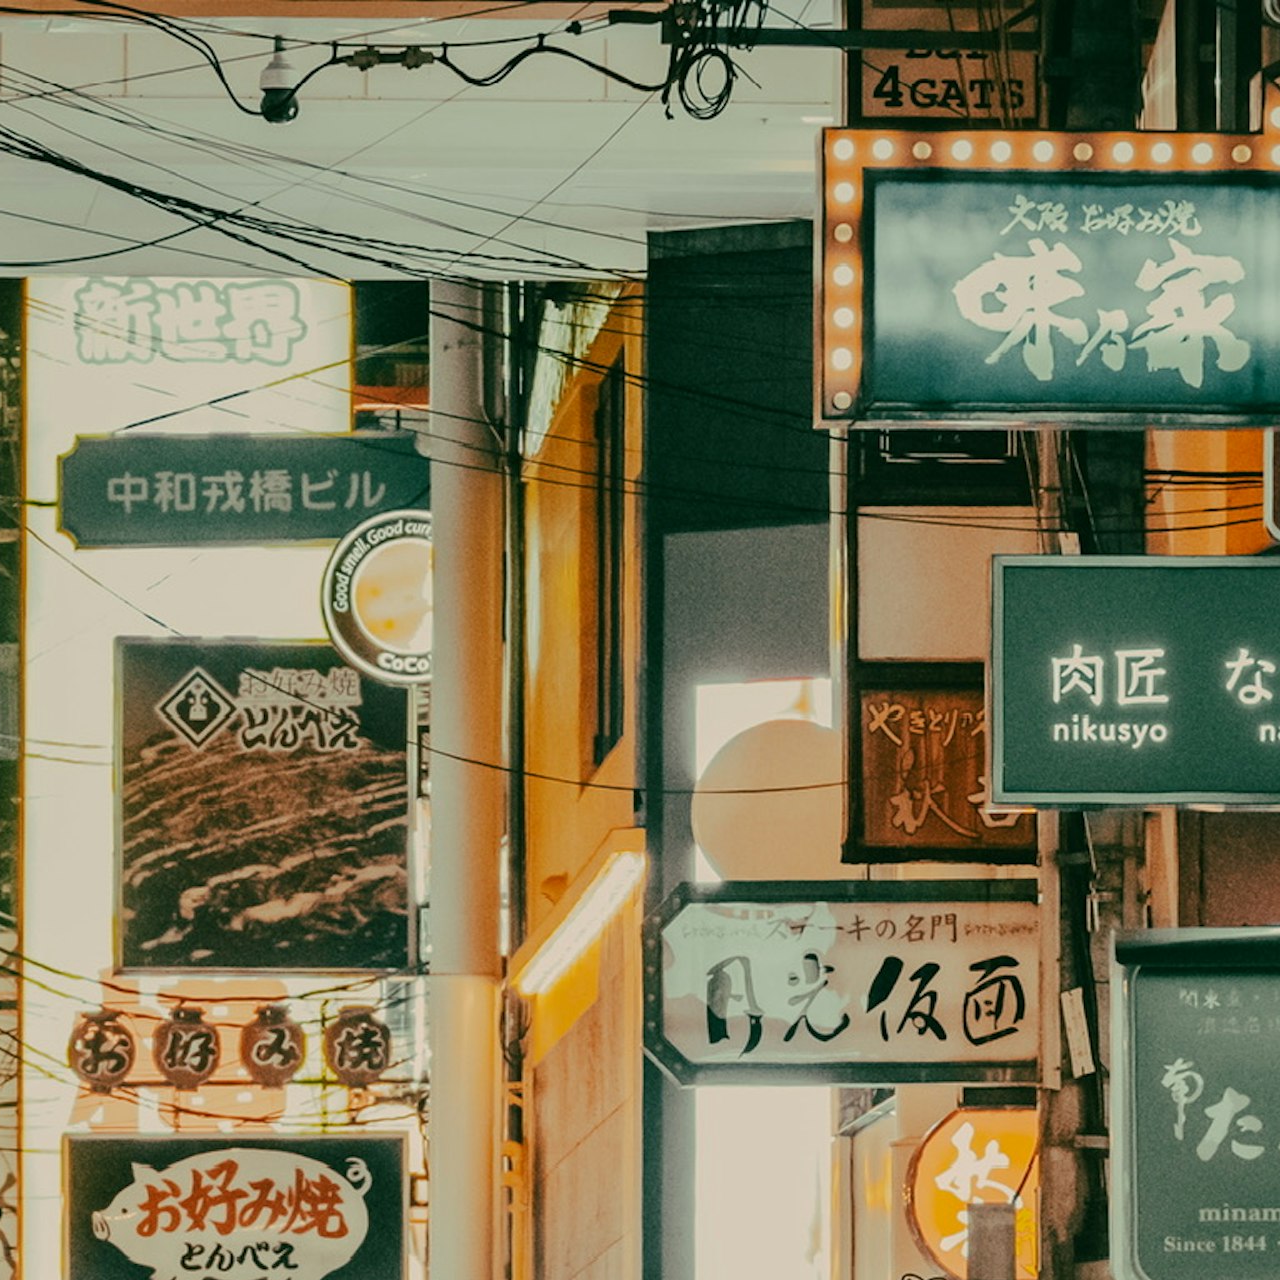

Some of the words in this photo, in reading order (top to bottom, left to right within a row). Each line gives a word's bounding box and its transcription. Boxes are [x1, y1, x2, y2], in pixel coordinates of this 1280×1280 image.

[107, 471, 387, 513] 中和戎橋ビル
[239, 668, 361, 700] お好み焼
[1051, 644, 1169, 706] 肉匠
[1053, 714, 1168, 748] nikusyo
[136, 1158, 348, 1240] お好み焼
[178, 1240, 299, 1273] とんべえ
[1164, 1235, 1216, 1254] Since
[1222, 1235, 1267, 1254] 1844
